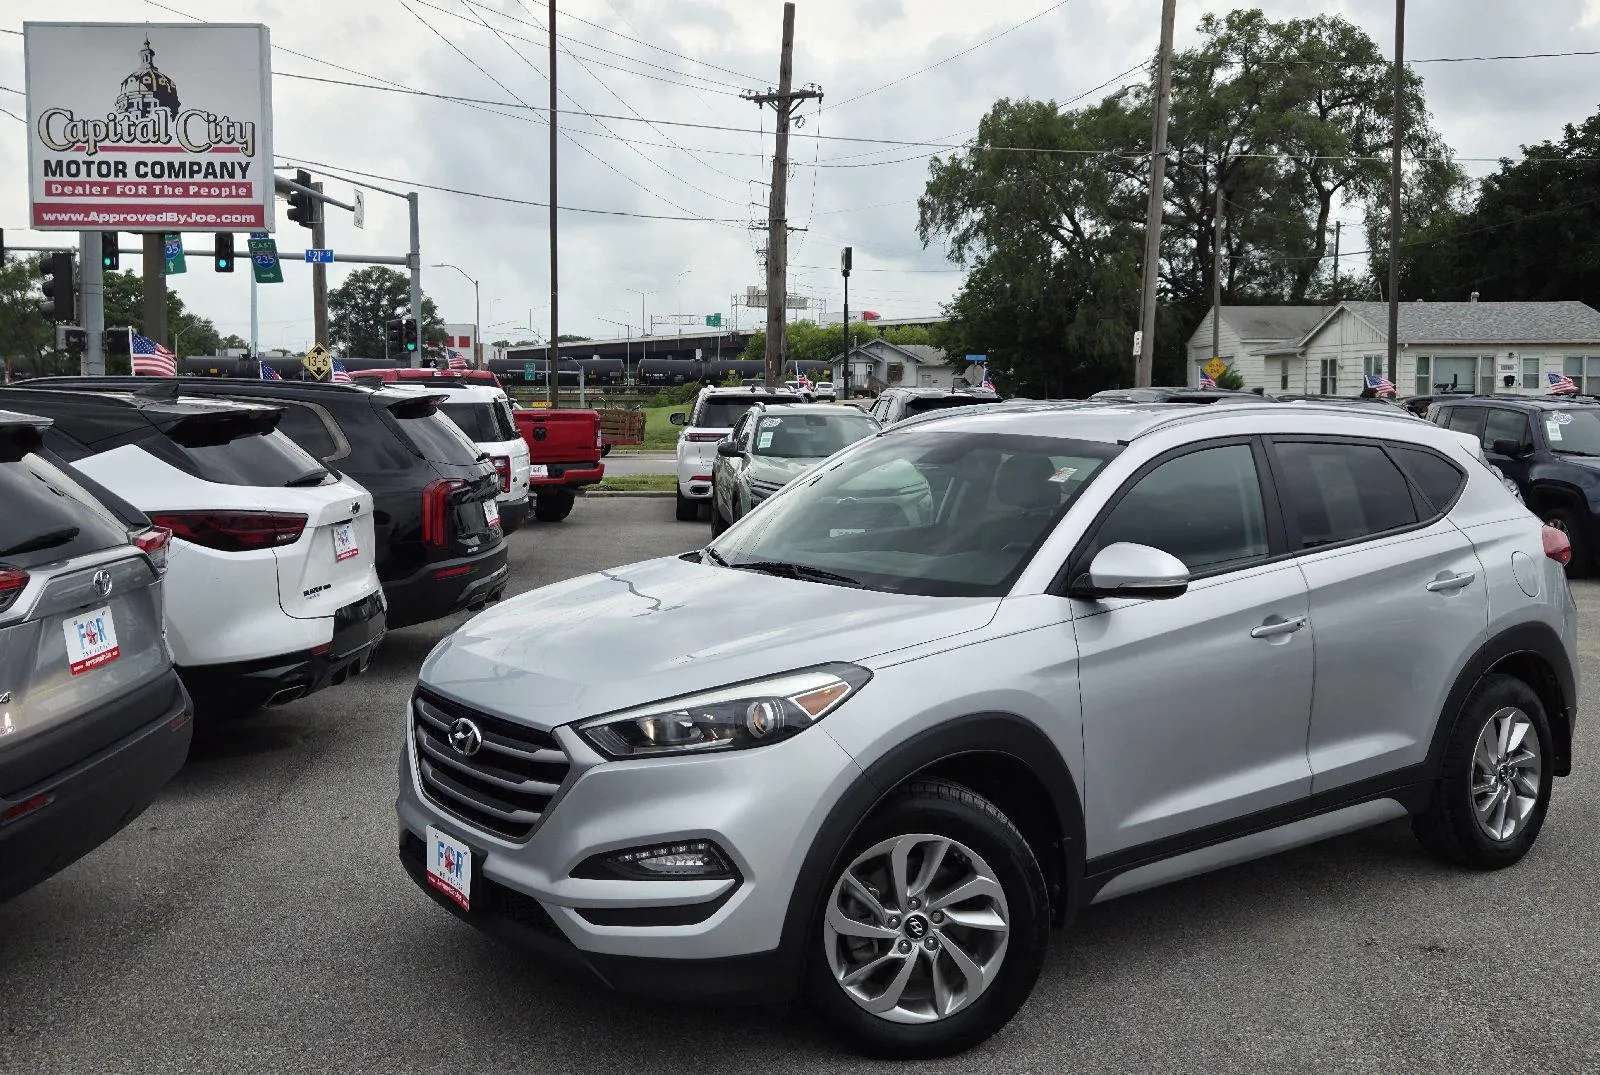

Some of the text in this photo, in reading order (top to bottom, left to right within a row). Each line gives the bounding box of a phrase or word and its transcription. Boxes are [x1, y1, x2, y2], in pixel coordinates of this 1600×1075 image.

[37, 107, 255, 157] Capital City
[43, 159, 251, 179] MOTOR COMPANY
[51, 183, 247, 197] Dealer FOR The People
[42, 211, 256, 224] www.ApprovedByJoe.com
[166, 243, 179, 254] 35
[251, 241, 273, 249] EAST
[255, 254, 275, 264] 235
